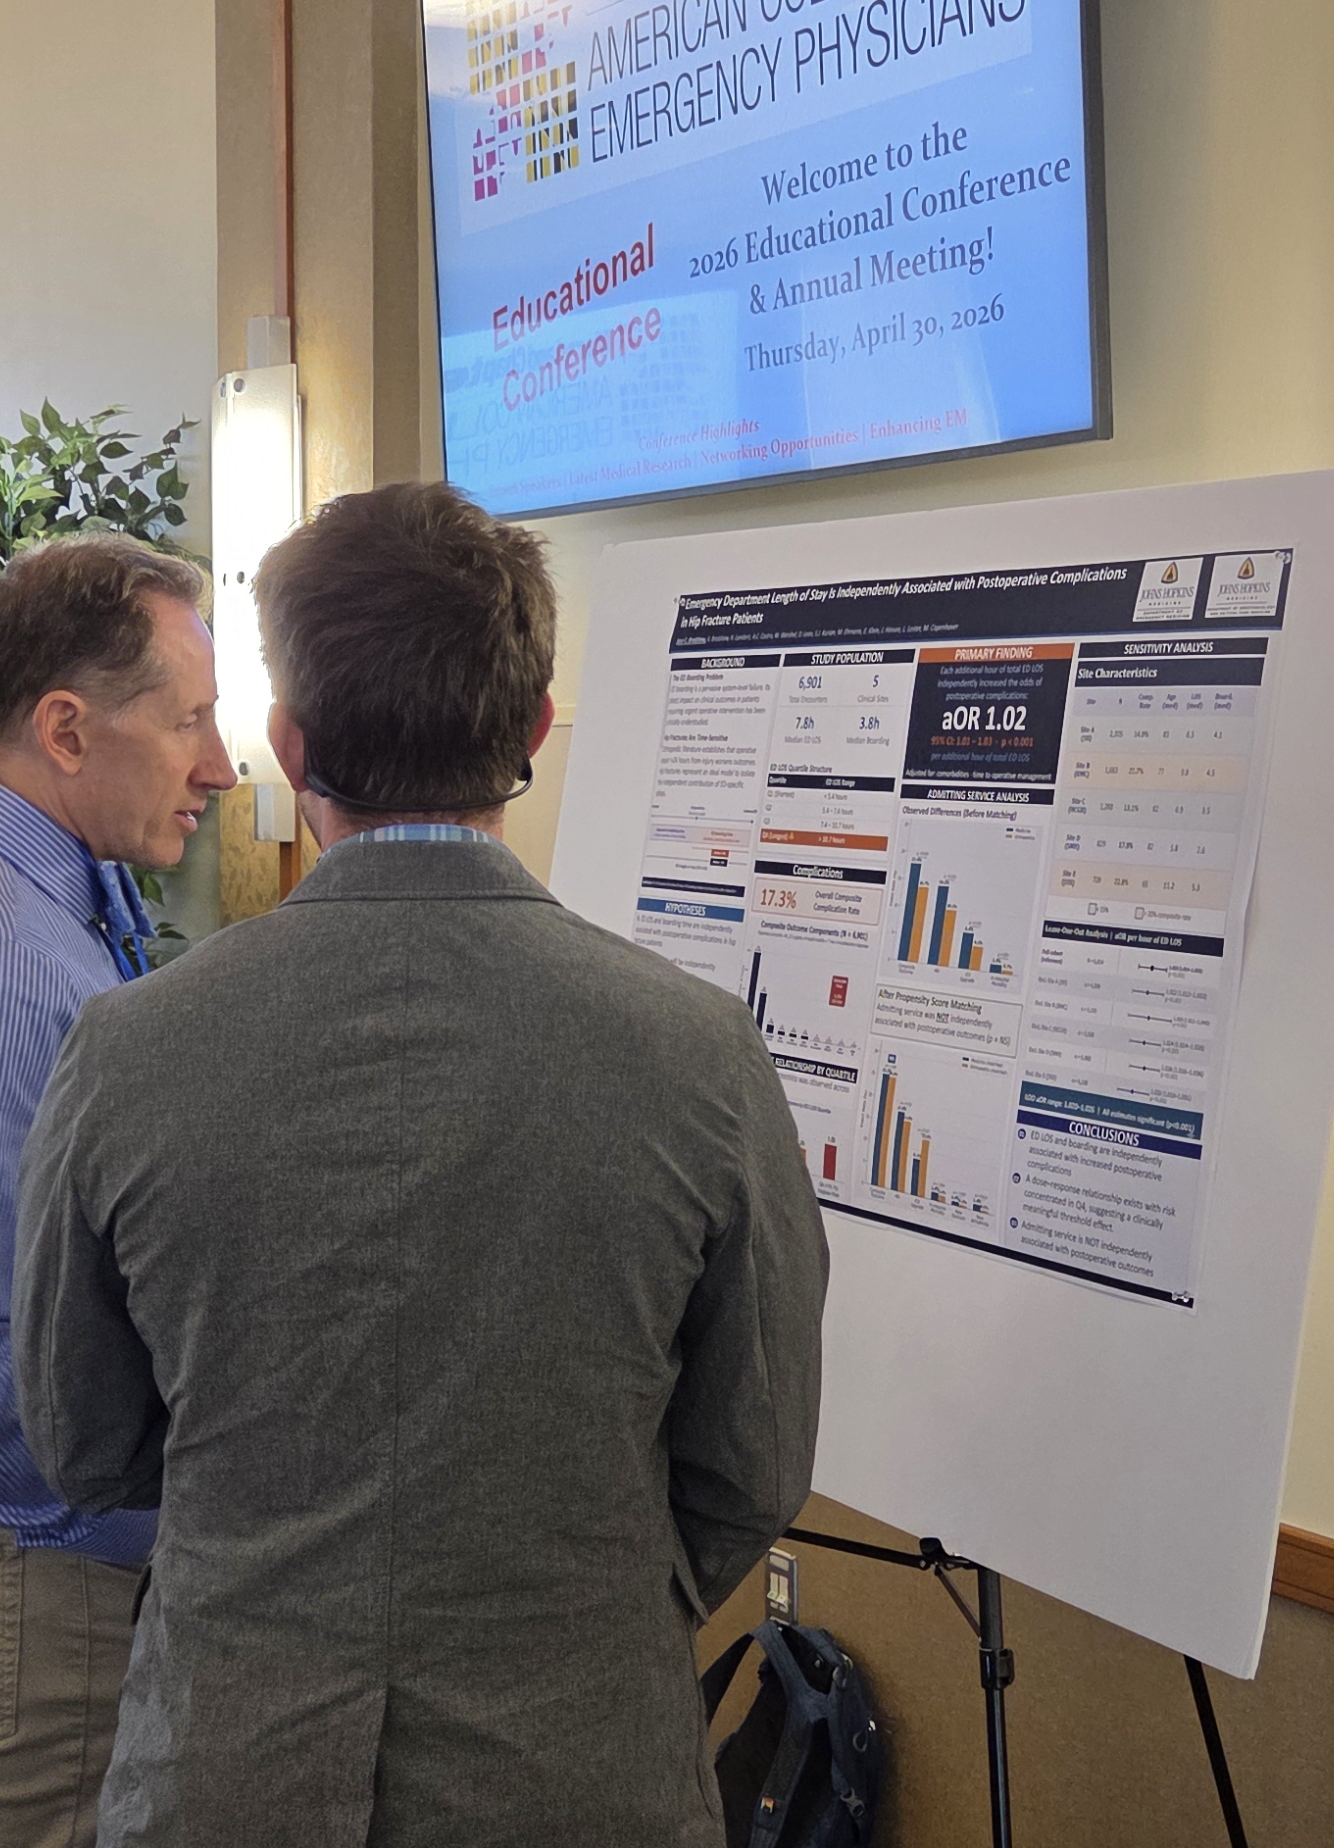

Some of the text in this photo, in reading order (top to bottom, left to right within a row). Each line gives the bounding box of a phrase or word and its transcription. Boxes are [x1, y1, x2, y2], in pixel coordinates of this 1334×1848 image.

[587, 0, 748, 91] AMERICAN
[591, 37, 782, 162] EMERGENCY
[761, 121, 968, 206] Welcome to the
[689, 157, 1072, 278] 2026 Educational Conference
[749, 226, 994, 315] & Annual Meeting!
[492, 222, 654, 352] Educational
[744, 293, 1005, 372] Thursday, April 30, 2026
[503, 307, 662, 411] Conference
[601, 461, 641, 481] Medical
[644, 455, 692, 474] Research
[701, 443, 768, 465] Networking
[771, 428, 858, 459] Opportunities
[870, 416, 942, 441] Enhancing
[945, 409, 967, 428] EM
[638, 418, 761, 453] Conference Highlights
[685, 566, 1127, 611] Emergency Department Length of Stay Is Independently Associated with Postoperative Complications
[1163, 586, 1195, 599] HOPKINS
[1240, 582, 1271, 594] HOPKINS
[688, 615, 700, 630] Hip
[701, 613, 731, 627] Fracture
[732, 611, 764, 625] Patients
[811, 651, 884, 665] STUDY POPULATION
[954, 646, 1033, 660] PRIMARY FINDING
[1124, 641, 1214, 655] SENSITIVITY ANALYSIS
[701, 657, 745, 669] BACKGROUND
[1078, 667, 1158, 679] Site Characteristics
[798, 676, 822, 690] 6,901
[872, 675, 879, 688] 5
[795, 716, 815, 730] 7.8h
[859, 716, 880, 730] 3.8h
[942, 705, 1027, 731] aOR 1.02
[927, 788, 1030, 803] ADMITTING SERVICE ANALYSIS
[792, 864, 844, 880] Complications
[760, 888, 797, 909] 17.3%
[664, 902, 706, 917] HYPOTHESES
[895, 991, 930, 1007] Propensity
[931, 996, 949, 1008] Score
[816, 1066, 825, 1076] BY
[1068, 1120, 1140, 1147] CONCLUSIONS
[1029, 1144, 1163, 1182] associated with increased postoperative
[1068, 1138, 1098, 1155] boarding
[1111, 1147, 1163, 1168] independently
[1027, 1159, 1072, 1177] complications
[1082, 1186, 1122, 1205] relationship
[1144, 1200, 1161, 1214] with
[1020, 1220, 1053, 1238] Admitting
[1054, 1228, 1077, 1242] service
[1100, 1239, 1153, 1262] independently
[1020, 1235, 1154, 1278] associated with postoperative outcomes
